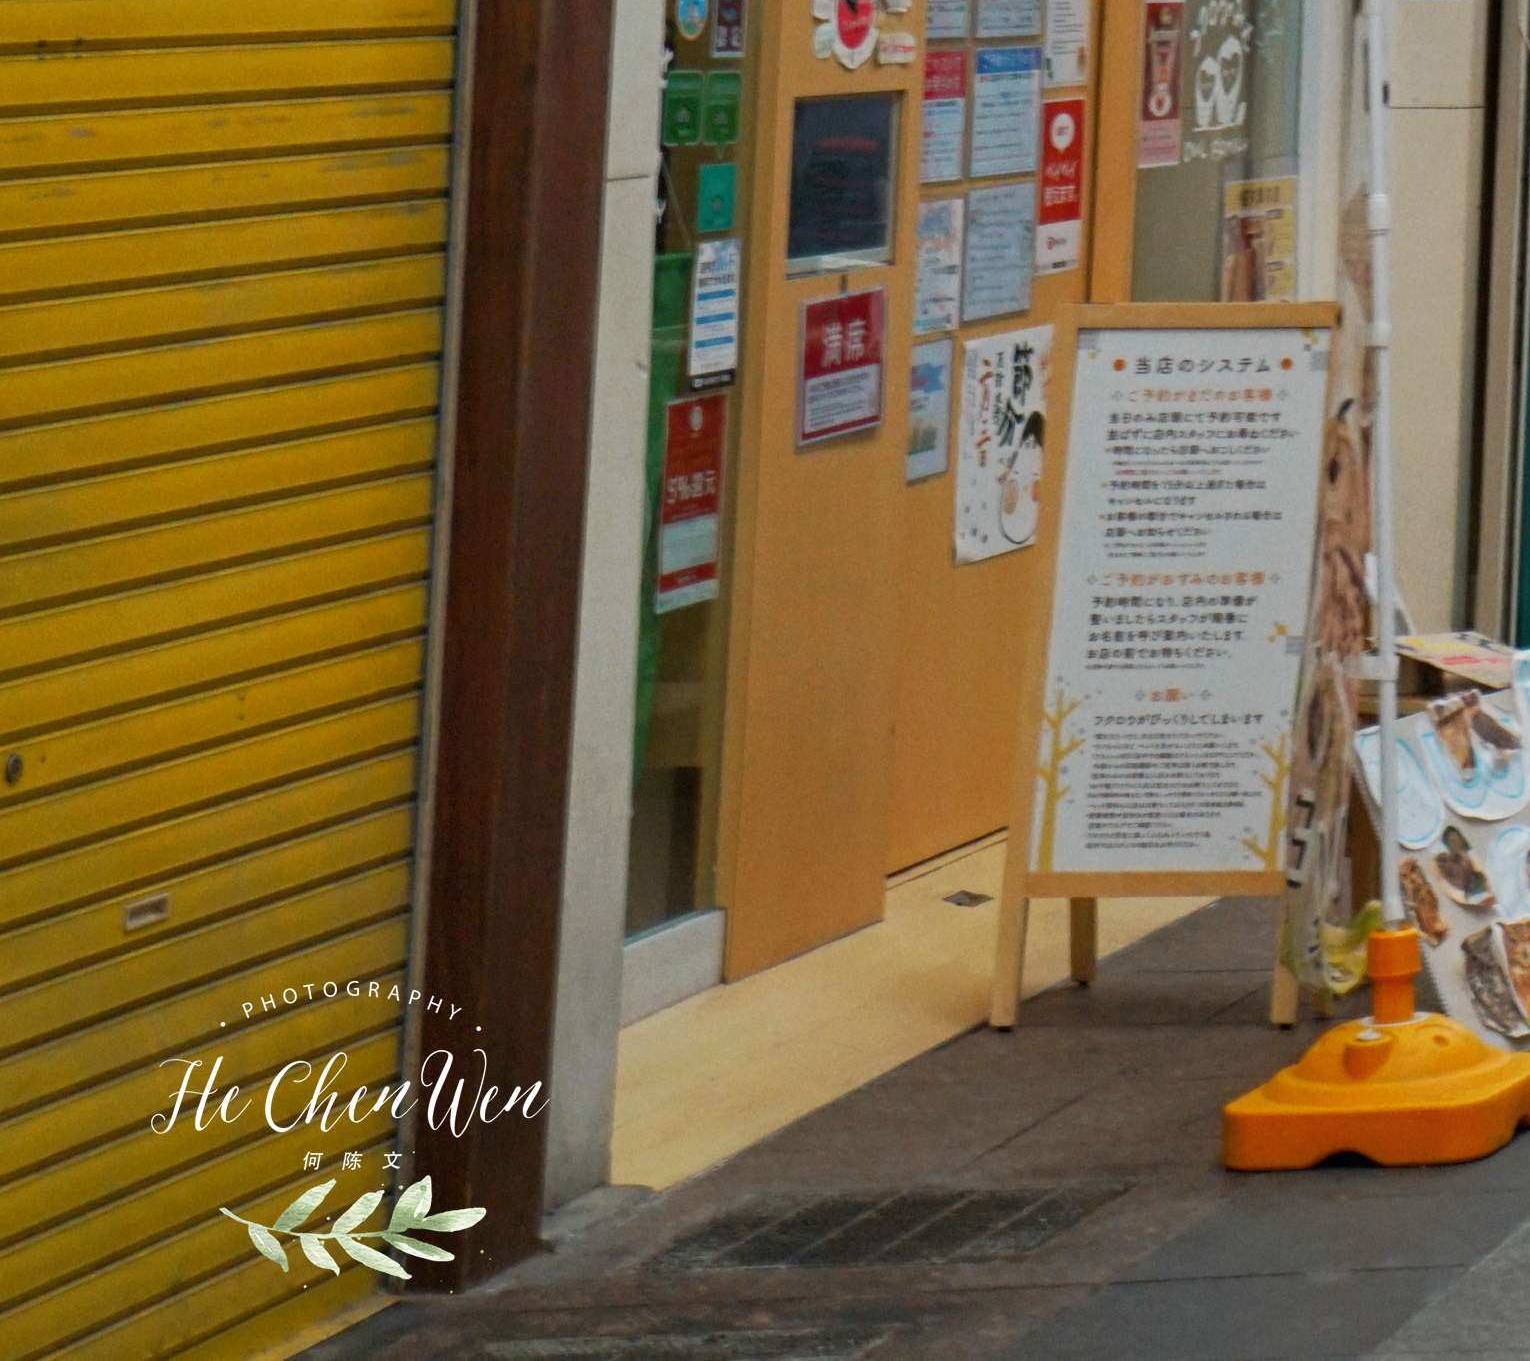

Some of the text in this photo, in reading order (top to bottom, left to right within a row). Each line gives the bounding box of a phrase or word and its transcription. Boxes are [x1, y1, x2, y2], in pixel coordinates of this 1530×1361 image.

[1135, 357, 1271, 375] 当店のシステム
